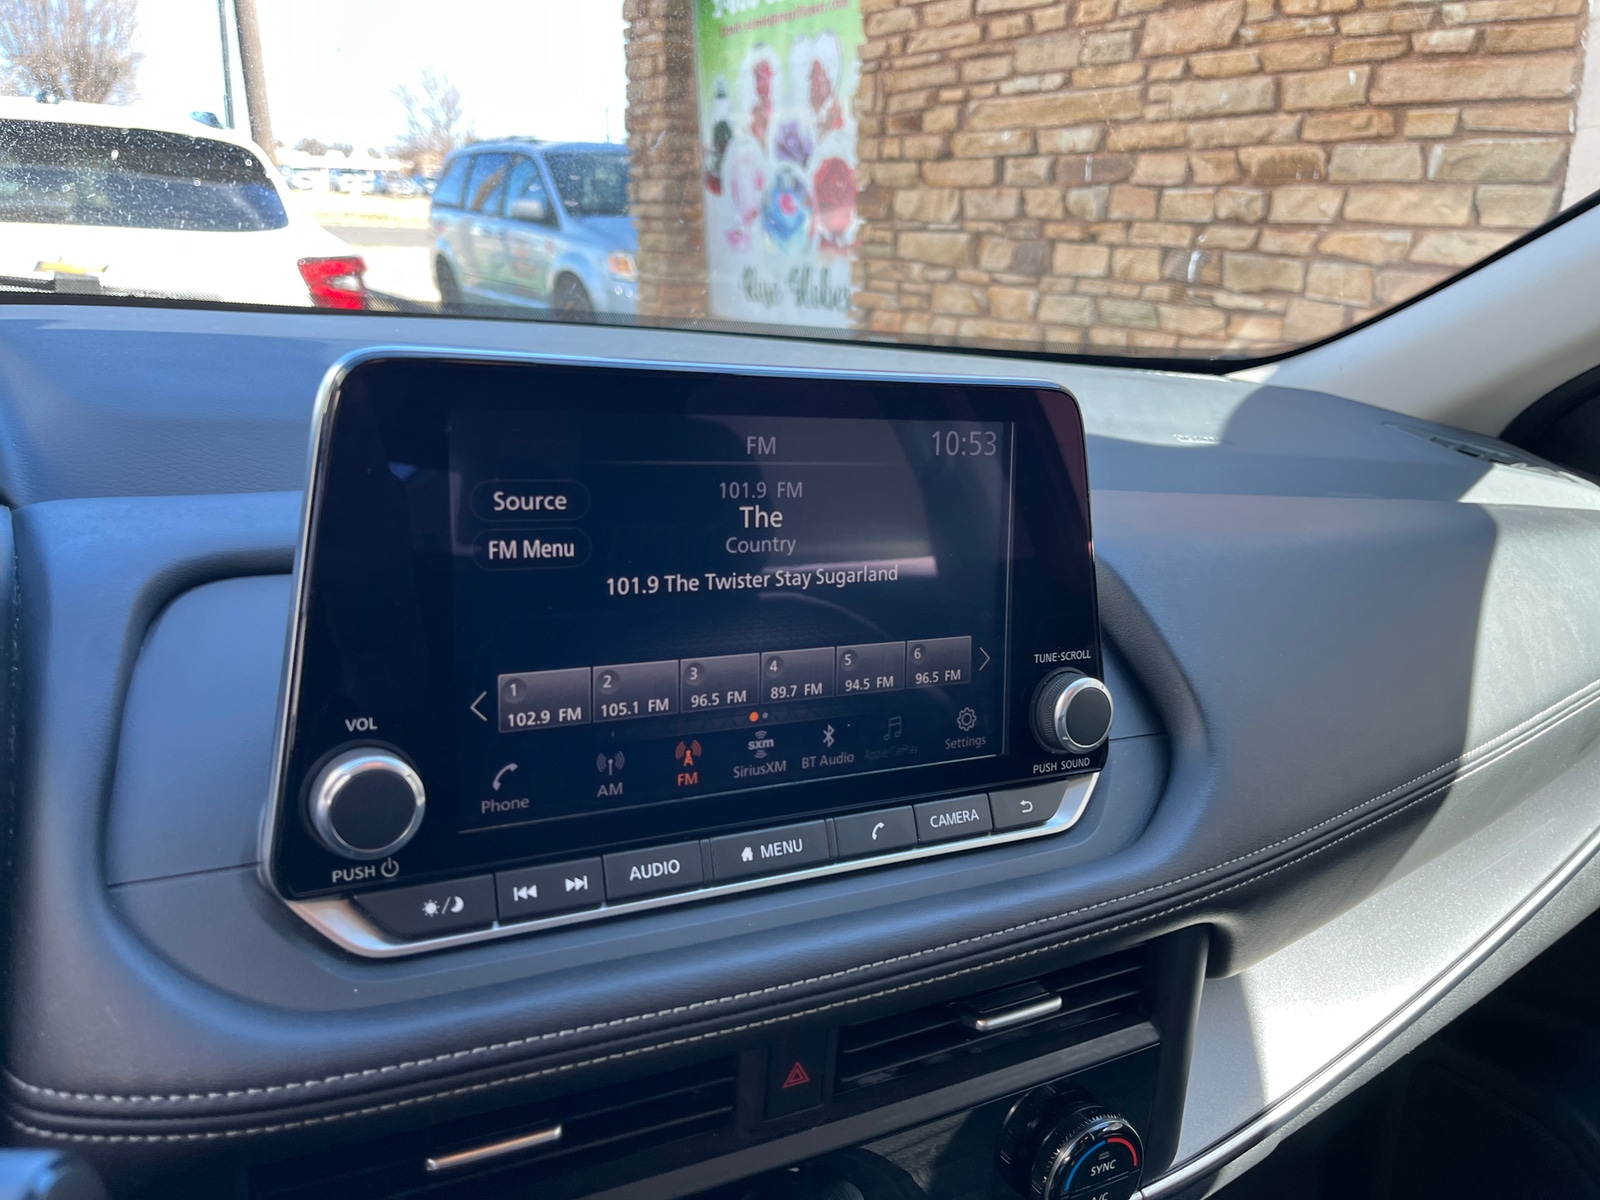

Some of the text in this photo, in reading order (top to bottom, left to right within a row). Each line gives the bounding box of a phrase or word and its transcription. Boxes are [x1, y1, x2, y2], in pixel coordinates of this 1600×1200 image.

[746, 436, 776, 455] FM
[932, 431, 997, 456] 10:53
[719, 482, 803, 499] 101.9 FM
[493, 492, 568, 511] Source
[738, 505, 783, 529] The
[488, 540, 575, 560] FM Menu
[725, 537, 797, 557] Country
[606, 564, 899, 596] 101.9 The Twister Stay Sugarland
[844, 654, 852, 666] 5
[913, 648, 922, 660] 6
[689, 667, 698, 681] 3
[769, 660, 778, 672] 4
[602, 675, 612, 689] 2
[845, 676, 894, 692] 94.5 FM
[915, 670, 961, 685] 96.5 FM
[510, 684, 517, 697] 1
[690, 690, 747, 708] 96.5 FM
[770, 683, 823, 700] 89.7 FM
[507, 707, 582, 727] 102.9 FM
[601, 698, 669, 718] 105.1 FM
[344, 718, 378, 732] VOL
[945, 735, 987, 751] Settings
[733, 760, 787, 779] SiriusXM
[801, 752, 855, 770] BT Audio
[1032, 756, 1091, 775] PUSH SOUND
[677, 772, 698, 786] FM
[596, 782, 623, 798] AM
[482, 796, 530, 814] Phone
[929, 809, 980, 828] CAMERA
[760, 839, 803, 859] MENU
[331, 866, 376, 883] PUSH
[629, 860, 681, 881] AUDIO
[1090, 1159, 1116, 1176] SYNC
